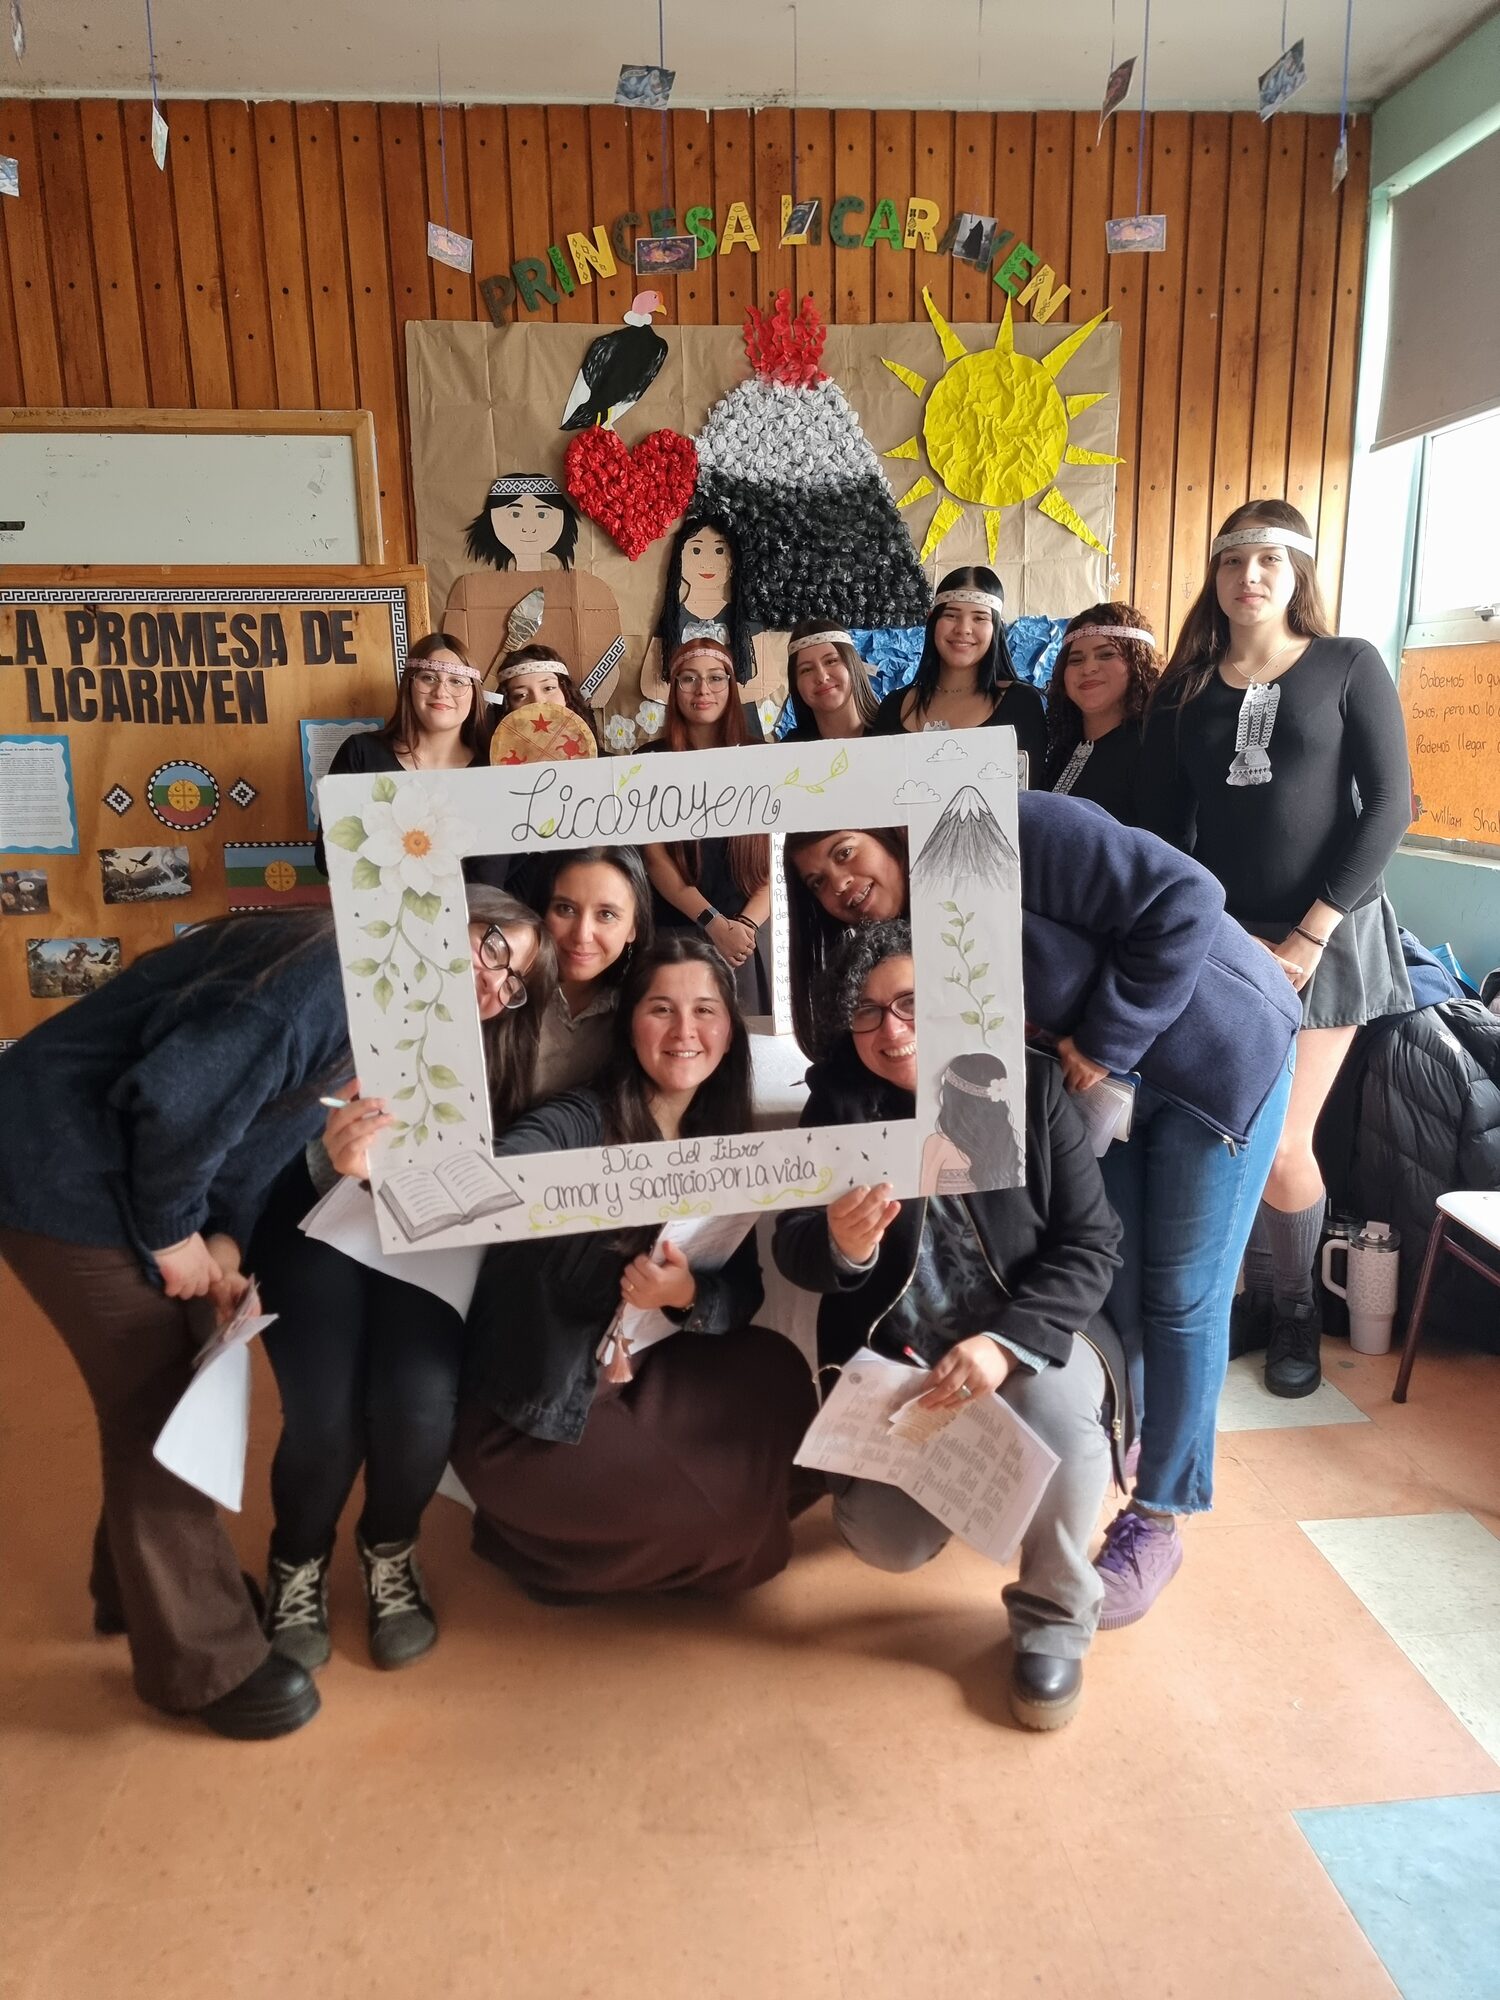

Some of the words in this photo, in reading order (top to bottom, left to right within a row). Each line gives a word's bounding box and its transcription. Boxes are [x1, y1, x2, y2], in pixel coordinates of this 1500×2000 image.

[65, 610, 289, 668] PROMESA
[301, 609, 358, 665] DE
[24, 667, 269, 725] LICARAYEN
[1473, 665, 1483, 685] lo
[1487, 672, 1500, 696] qu
[1444, 705, 1465, 722] pero
[1486, 701, 1495, 717] lo
[1458, 732, 1487, 758] llegar
[508, 768, 782, 842] Licarayen
[1473, 807, 1500, 833] Sha
[602, 1147, 653, 1176] Día
[667, 1139, 700, 1166] del
[710, 1137, 765, 1161] Libro
[544, 1182, 600, 1211] amor
[605, 1182, 624, 1218] y
[772, 1155, 817, 1184] vida
